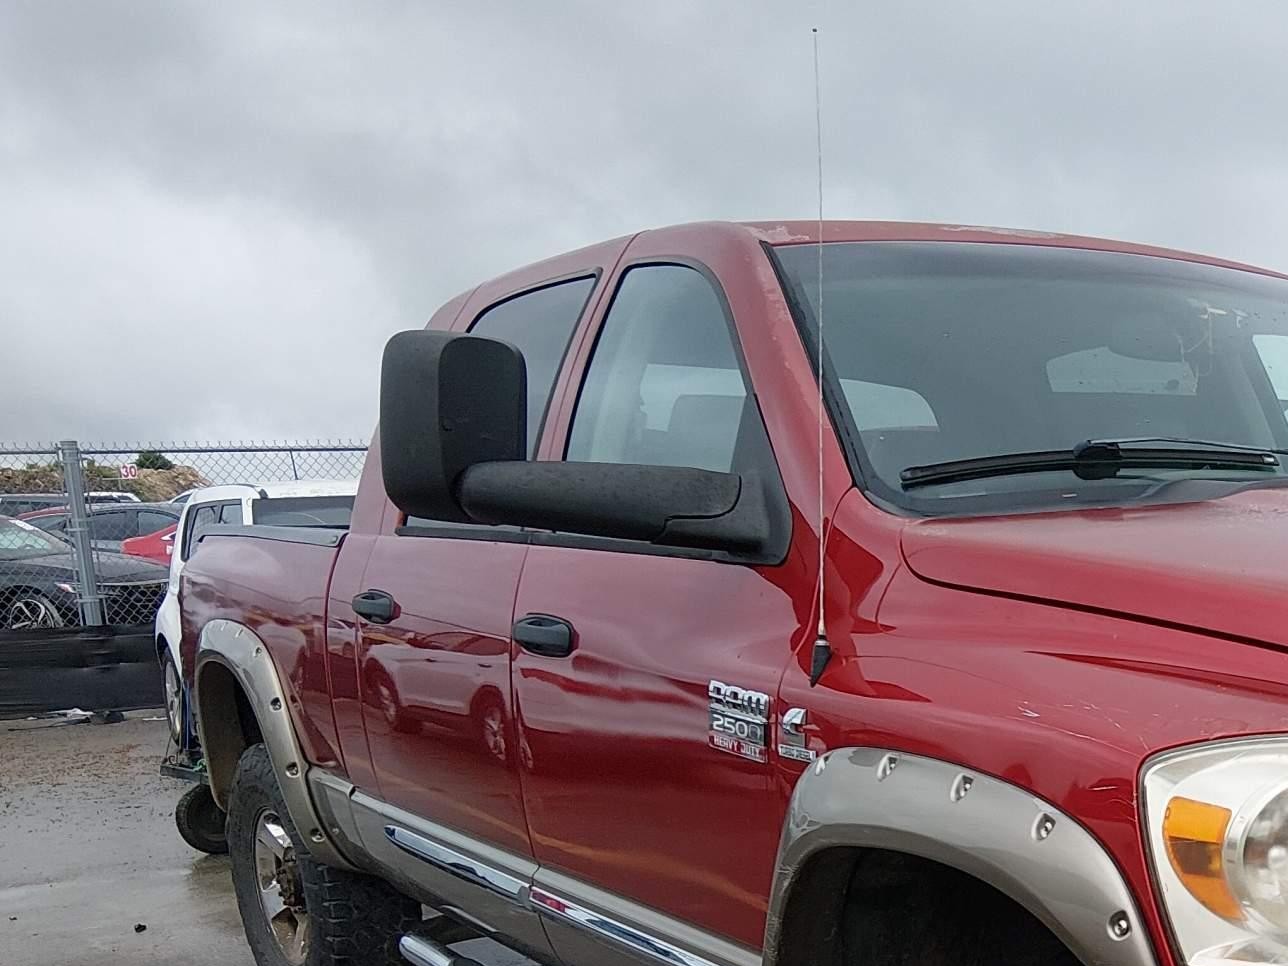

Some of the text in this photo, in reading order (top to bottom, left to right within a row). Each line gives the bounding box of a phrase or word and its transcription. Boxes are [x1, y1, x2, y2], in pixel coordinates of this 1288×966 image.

[121, 465, 137, 478] 30
[712, 714, 761, 741] 2500
[713, 735, 761, 758] HEAVY DUTY
